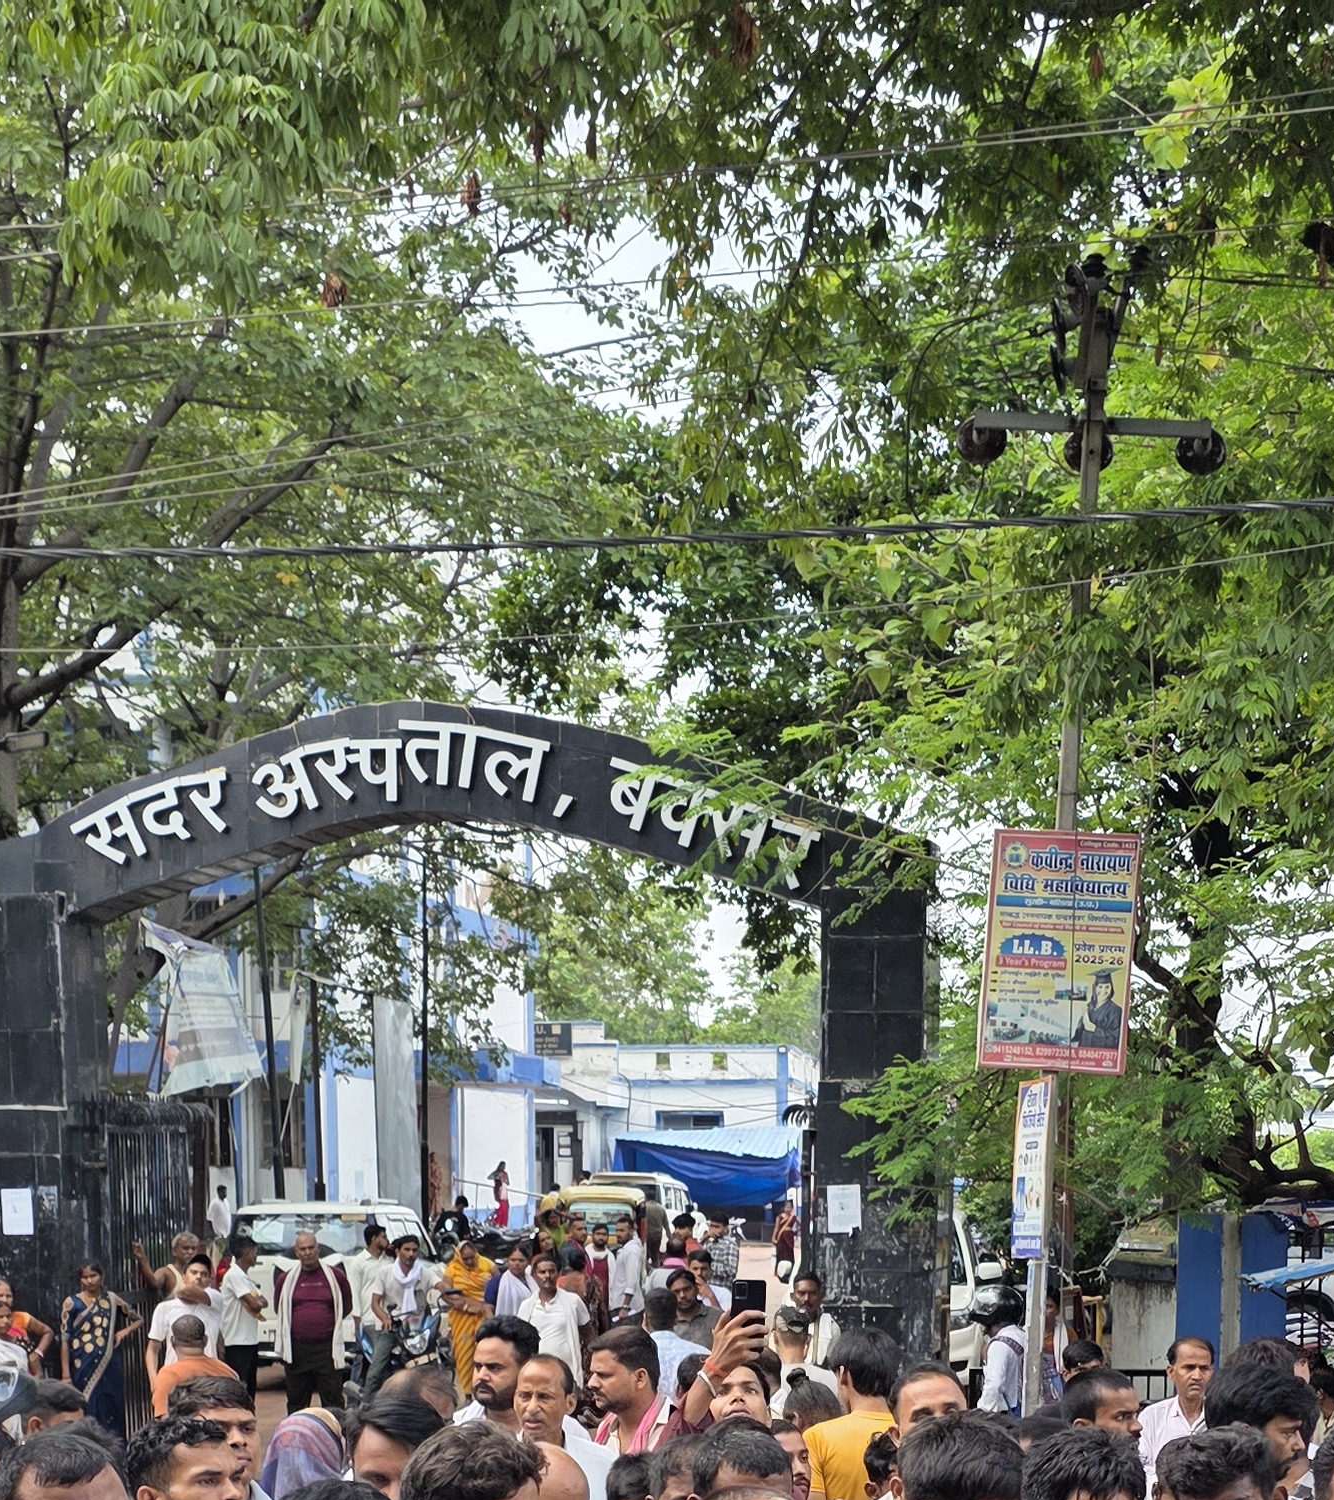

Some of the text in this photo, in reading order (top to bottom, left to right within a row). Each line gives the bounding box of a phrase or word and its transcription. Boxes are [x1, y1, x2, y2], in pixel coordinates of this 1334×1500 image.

[69, 766, 227, 866] सदर
[251, 719, 574, 820] अस्पताल,
[1030, 846, 1133, 873] कवीन्द्र नारायण
[1003, 873, 1129, 897] विधि महाविद्यालय
[1012, 939, 1058, 956] LL.B.
[998, 956, 1065, 969] 3 Year's Program
[1075, 954, 1124, 966] 2025-26
